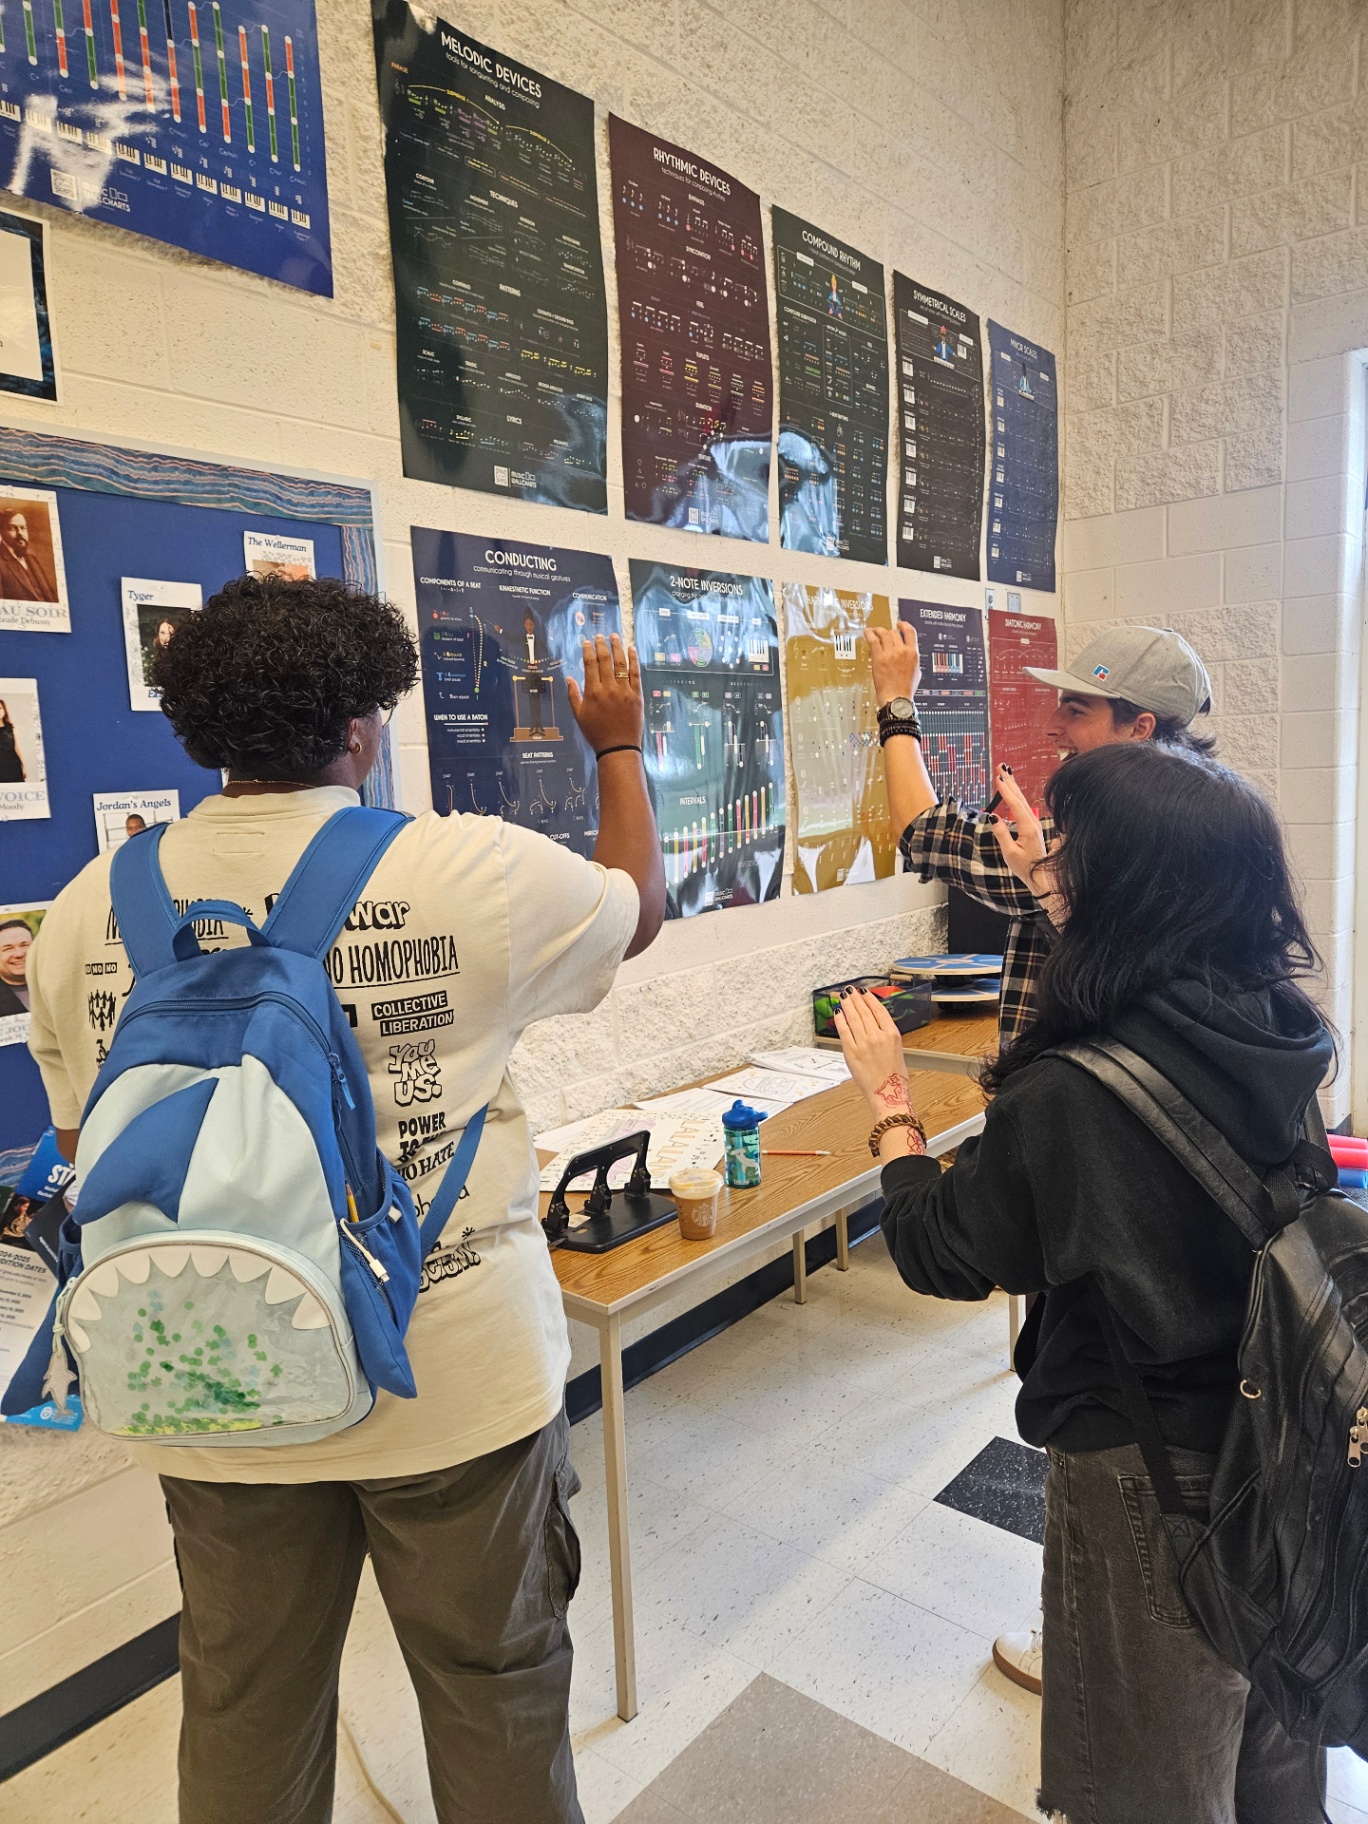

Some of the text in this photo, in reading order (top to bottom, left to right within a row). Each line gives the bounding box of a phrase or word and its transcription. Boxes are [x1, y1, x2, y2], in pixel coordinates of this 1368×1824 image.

[441, 31, 542, 98] MELODIC DEVICES
[446, 52, 460, 64] tools
[469, 66, 499, 88] songwriting
[499, 79, 511, 93] and
[511, 88, 540, 109] composing
[653, 147, 698, 178] RHYTHMIC
[699, 168, 731, 196] DEVICES
[802, 230, 861, 272] COMPOUND RHYTHM
[913, 289, 967, 323] SYMMETRICAL SCALES
[248, 537, 307, 552] The Wellerman
[485, 550, 557, 571] CONDUCTING
[420, 577, 456, 587] COMPONENTS
[473, 565, 513, 577] communicating
[513, 569, 532, 579] through
[533, 571, 550, 581] musical
[529, 587, 551, 596] FUNCTION
[670, 575, 743, 595] 2-NOTE INVERSIONS
[128, 590, 154, 601] Tyger
[26, 606, 68, 618] SOIR
[919, 608, 966, 622] EXTENDED HARMONY
[1005, 618, 1041, 631] DIATONIC HARMONY
[433, 713, 488, 721] WHEN TO USE A BATON
[97, 799, 171, 811] Jordan's Angels
[679, 796, 706, 805] INTERVALS
[105, 962, 117, 973] NO
[348, 935, 459, 984] HOMOPHOBIA
[373, 993, 447, 1018] COLLECTIVE
[381, 1013, 454, 1035] LIBERATION
[398, 1111, 446, 1139] POWER
[418, 1141, 455, 1177] HATE
